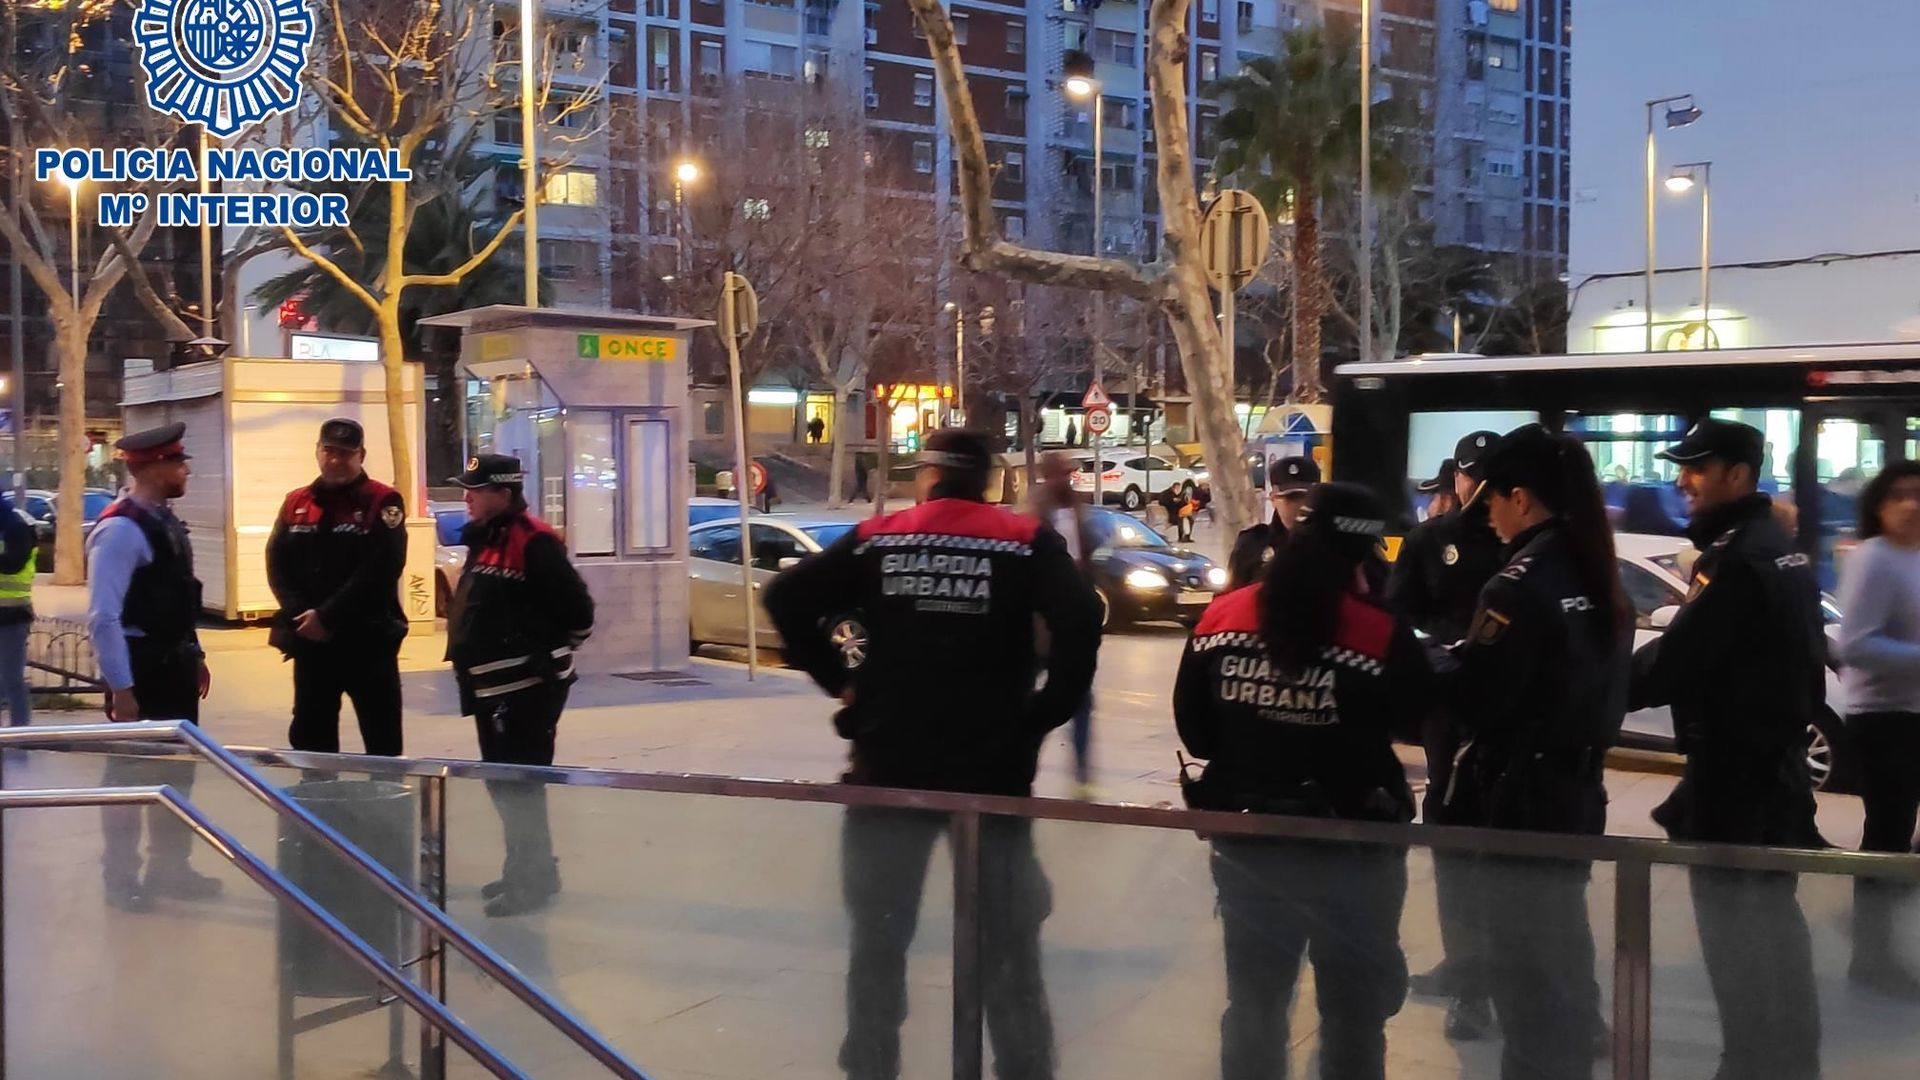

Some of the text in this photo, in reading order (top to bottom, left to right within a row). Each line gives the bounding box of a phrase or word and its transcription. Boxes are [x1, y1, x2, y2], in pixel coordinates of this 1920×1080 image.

[608, 340, 667, 357] ONCE
[1092, 416, 1106, 425] 30
[881, 576, 991, 599] URBANA
[1220, 680, 1338, 710] URBANA
